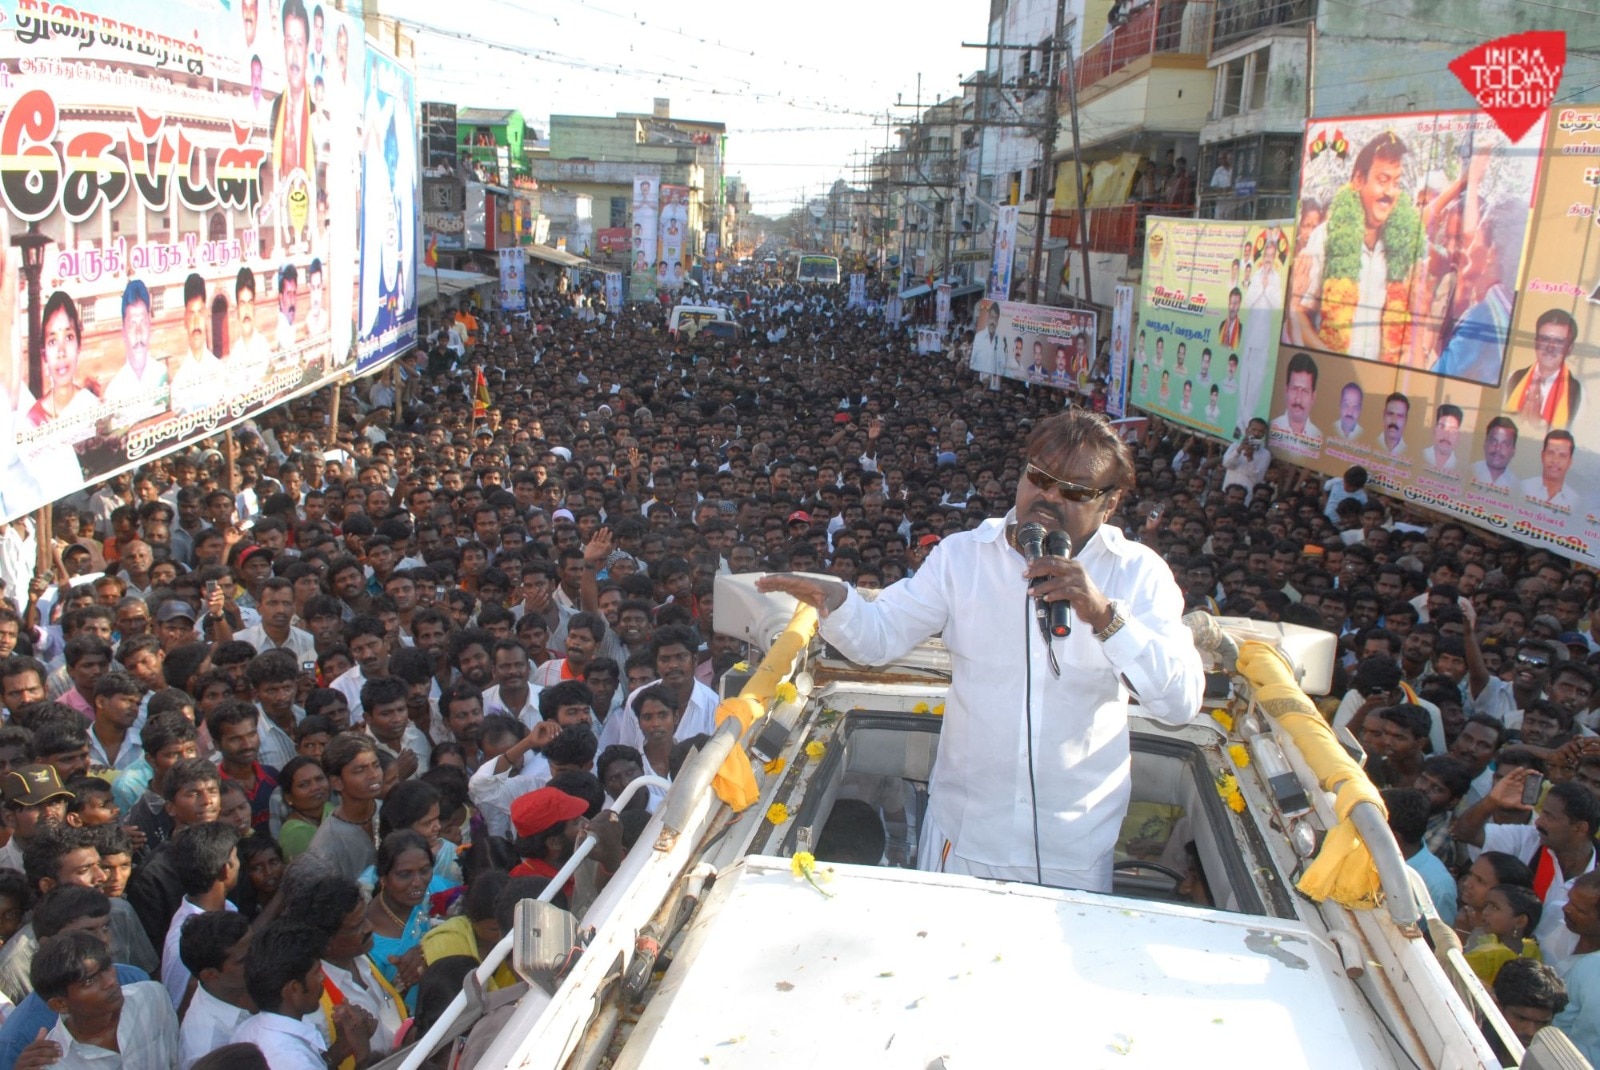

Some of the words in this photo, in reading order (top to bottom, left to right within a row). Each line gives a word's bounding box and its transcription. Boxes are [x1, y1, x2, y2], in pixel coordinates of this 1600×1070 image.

[1, 90, 264, 217] கேப்டன்
[1146, 319, 1175, 335] வருக!
[127, 394, 229, 460] துறையூர்
[231, 367, 302, 417] ஒன்றியம்
[1404, 485, 1508, 529] முற்போக்கு
[1512, 519, 1596, 559] திராவிட
